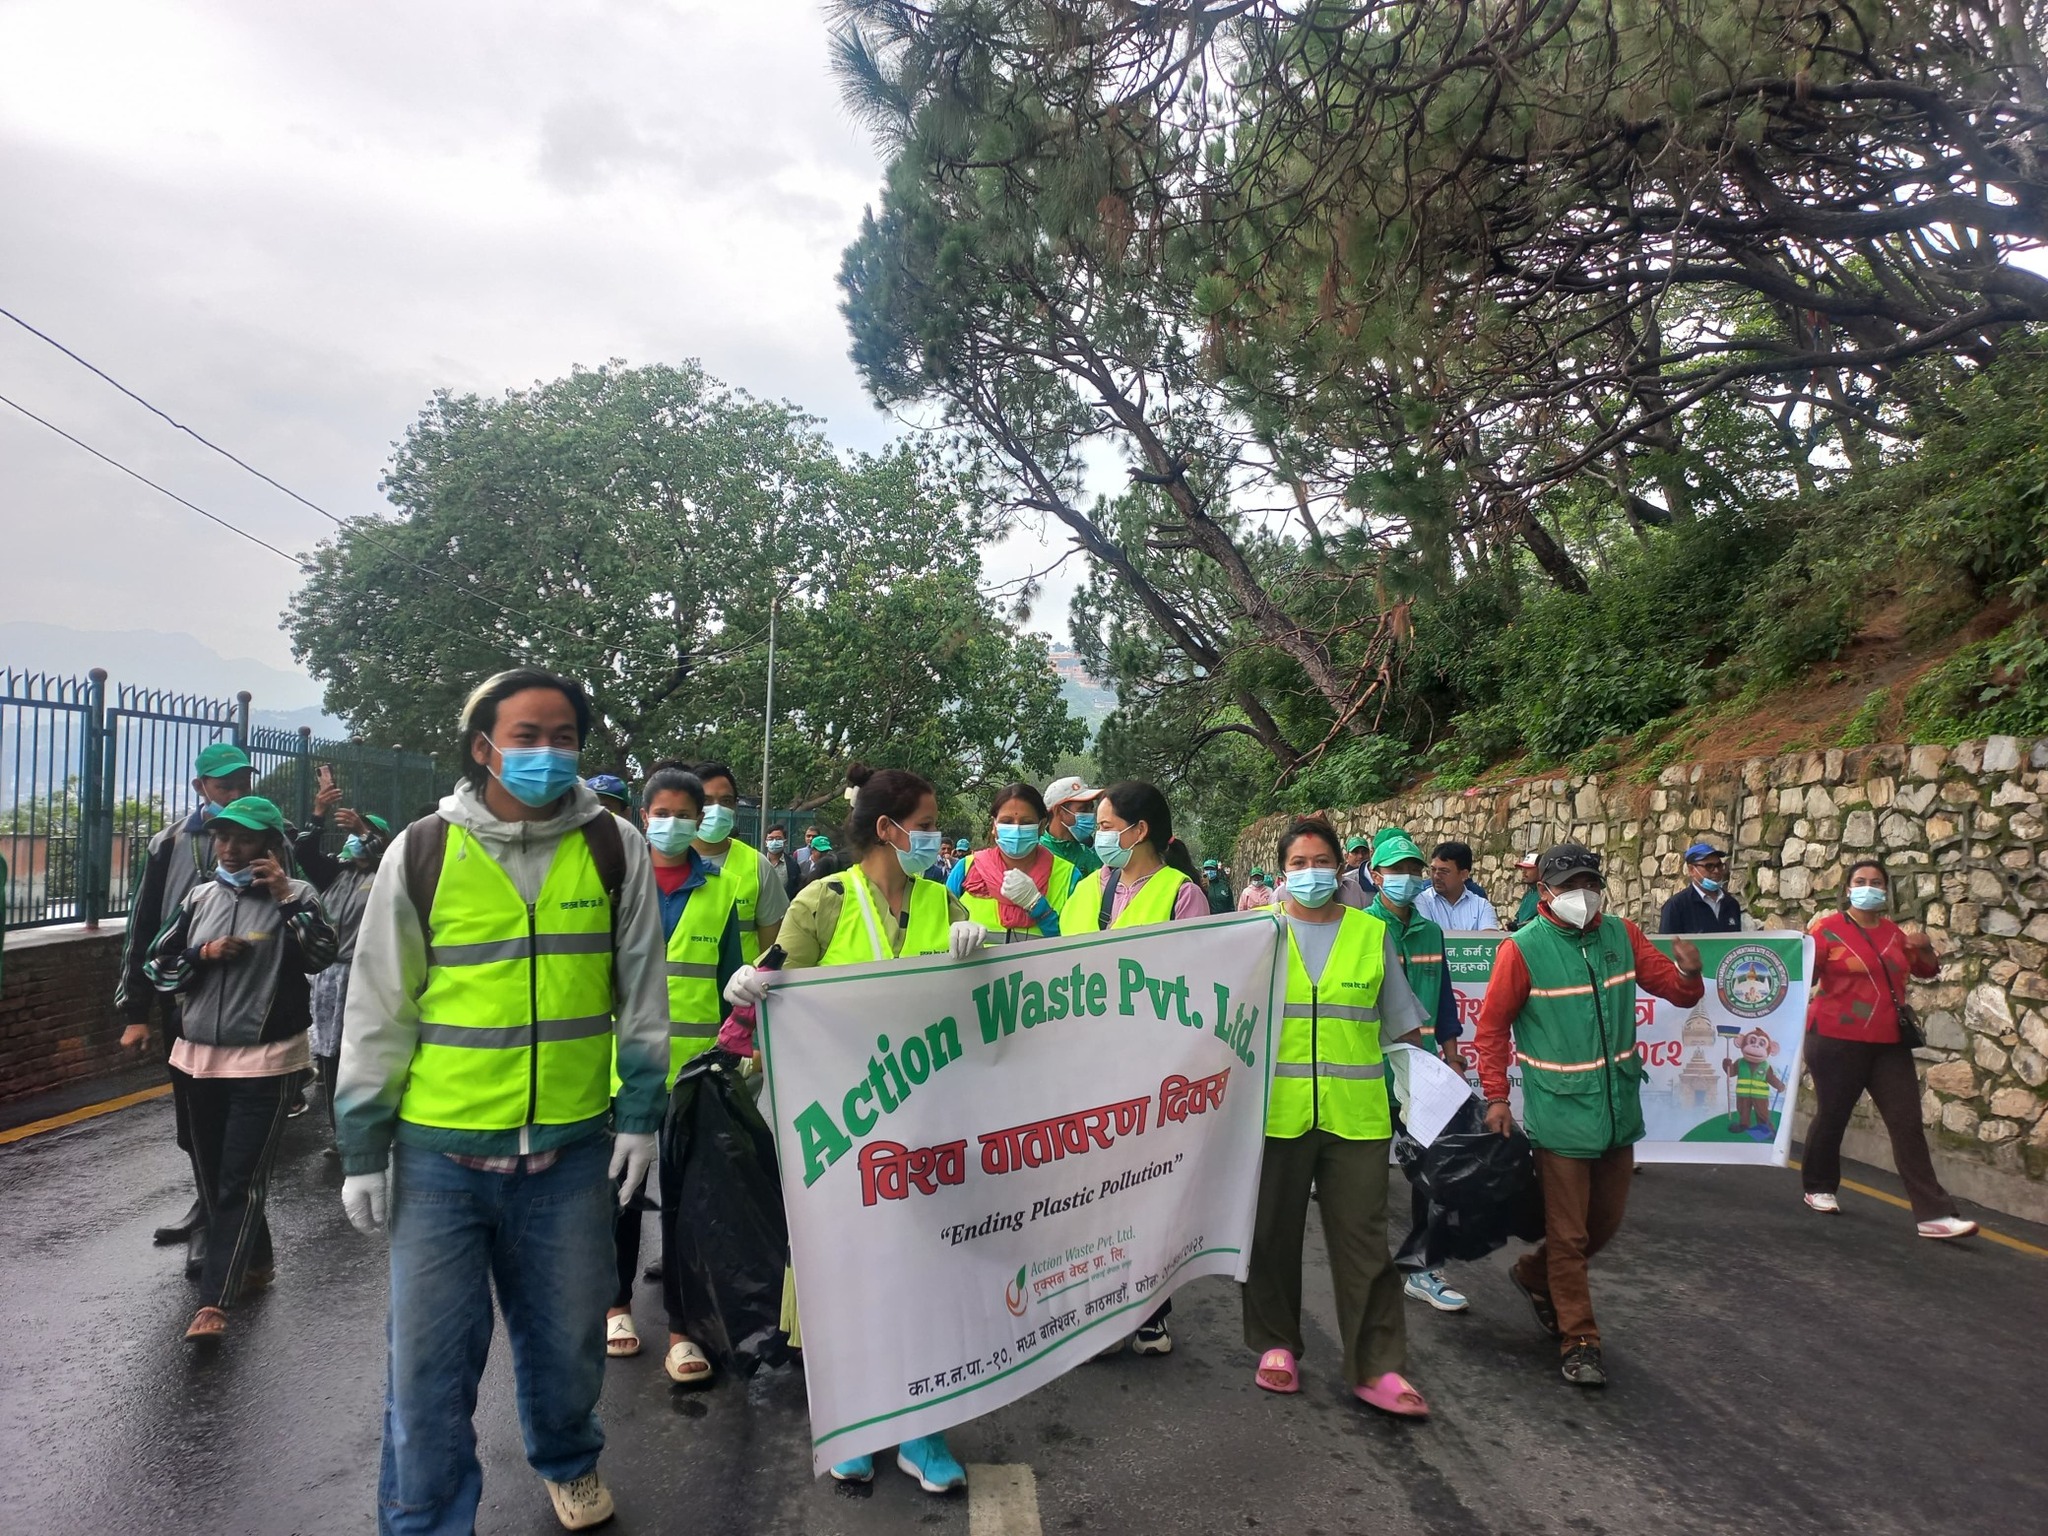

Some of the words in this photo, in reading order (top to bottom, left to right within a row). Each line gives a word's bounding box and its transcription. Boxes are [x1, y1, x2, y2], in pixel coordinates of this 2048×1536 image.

[1462, 945, 1484, 957] कर्म
[1485, 947, 1493, 957] र
[794, 1012, 964, 1189] Action
[972, 963, 1108, 1046] Waste
[1118, 958, 1204, 1030] Pvt.
[1213, 982, 1260, 1068] Ltd.
[1635, 1041, 1682, 1067] ०८२
[857, 1138, 967, 1207] विश्व
[978, 1095, 1151, 1178] वातावरण
[1156, 1067, 1231, 1129] दिवस
[940, 1210, 1026, 1246] “Ending
[1030, 1187, 1095, 1222] Plastic
[1098, 1153, 1184, 1200] Pollution”
[1030, 1253, 1063, 1277] Action
[1065, 1241, 1095, 1262] Waste
[1097, 1235, 1115, 1251] Pvt.
[1117, 1225, 1136, 1242] Ltd.
[1032, 1269, 1065, 1296] एक्सन
[1093, 1254, 1107, 1269] प्रा.
[1110, 1246, 1126, 1262] लि.
[1016, 1331, 1036, 1354] मध्य
[1039, 1308, 1080, 1339] बानेश्वर,
